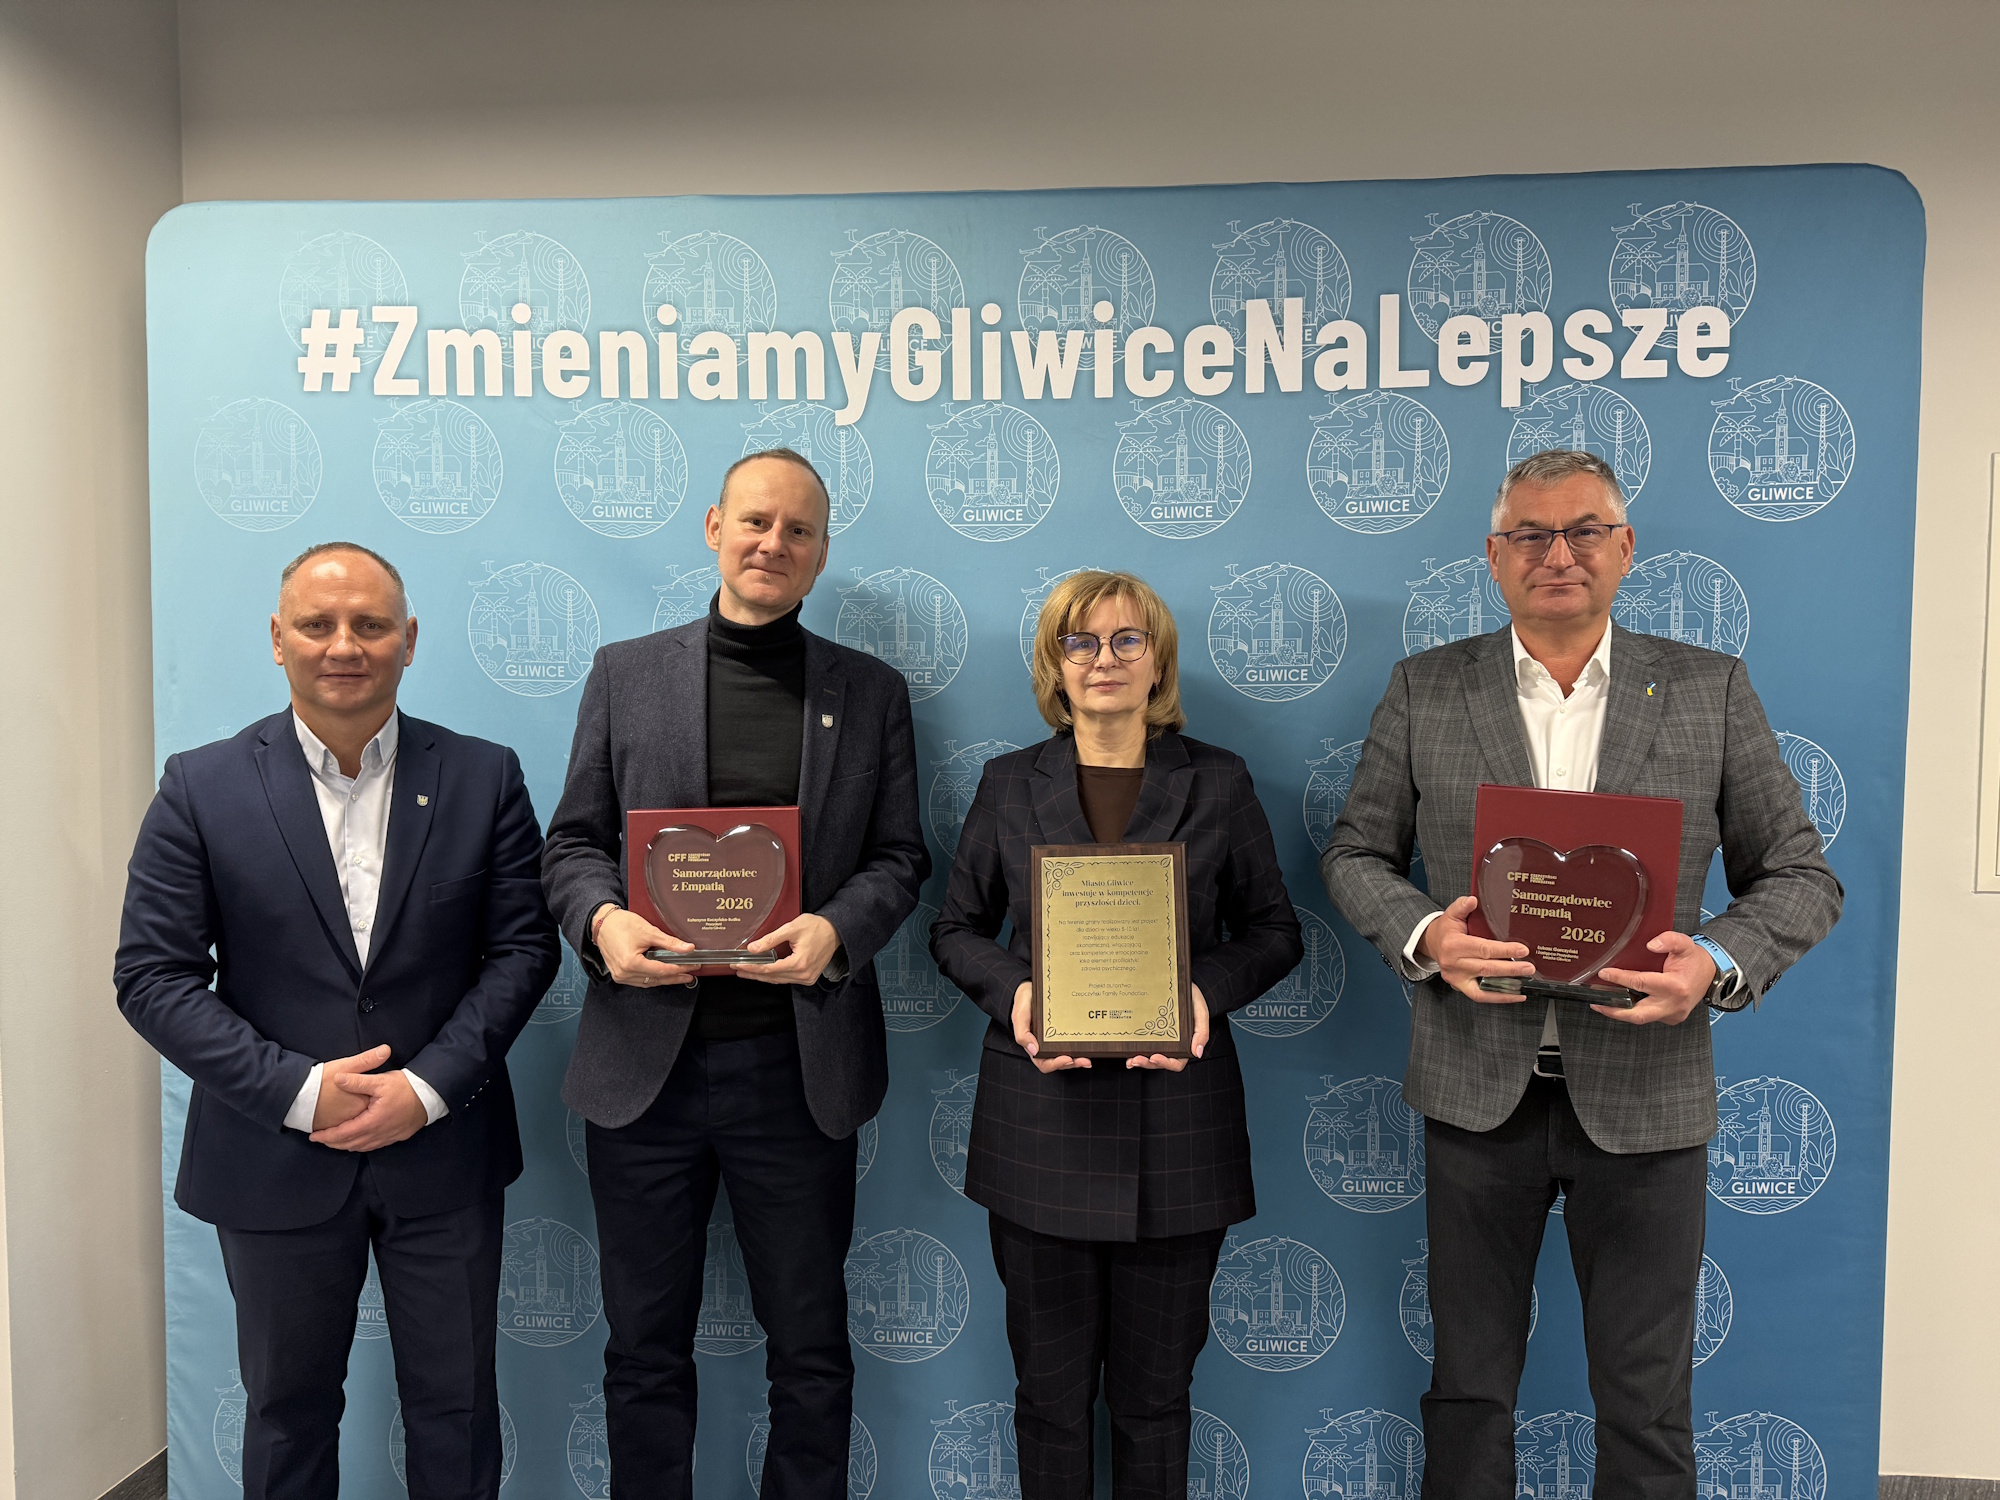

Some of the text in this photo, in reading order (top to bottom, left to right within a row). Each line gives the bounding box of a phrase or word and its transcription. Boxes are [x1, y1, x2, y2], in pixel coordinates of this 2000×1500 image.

[297, 294, 1730, 426] #ZmieniamyGliwiceNaLepsze
[1748, 486, 1814, 501] GLIWICE
[231, 500, 288, 513] GLIWICE
[410, 502, 468, 514] GLIWICE
[592, 505, 652, 519] GLIWICE
[1151, 505, 1213, 520] GLIWICE
[1345, 499, 1410, 514] GLIWICE
[963, 509, 1023, 522] GLIWICE
[506, 664, 565, 678] GLIWICE
[1245, 668, 1308, 682] GLIWICE
[668, 853, 687, 862] CFF
[672, 868, 758, 880] Samorządowiec
[1507, 871, 1529, 882] CFF
[681, 882, 725, 893] Empatią
[1062, 890, 1097, 898] inwestuje
[1107, 889, 1154, 897] kompetencje
[716, 897, 753, 910] 2026
[1075, 898, 1141, 908] przyszłości dzieci.
[1512, 888, 1612, 908] Samorządowiec
[1510, 904, 1572, 921] z Empatią
[1561, 926, 1605, 943] 2026
[1088, 1010, 1108, 1019] CFF
[1245, 1004, 1306, 1018] GLIWICE
[1342, 1180, 1405, 1194] GLIWICE
[1731, 1181, 1796, 1196] GLIWICE
[513, 1315, 571, 1329] GLIWICE
[873, 1330, 933, 1344] GLIWICE
[1246, 1339, 1308, 1353] GLIWICE
